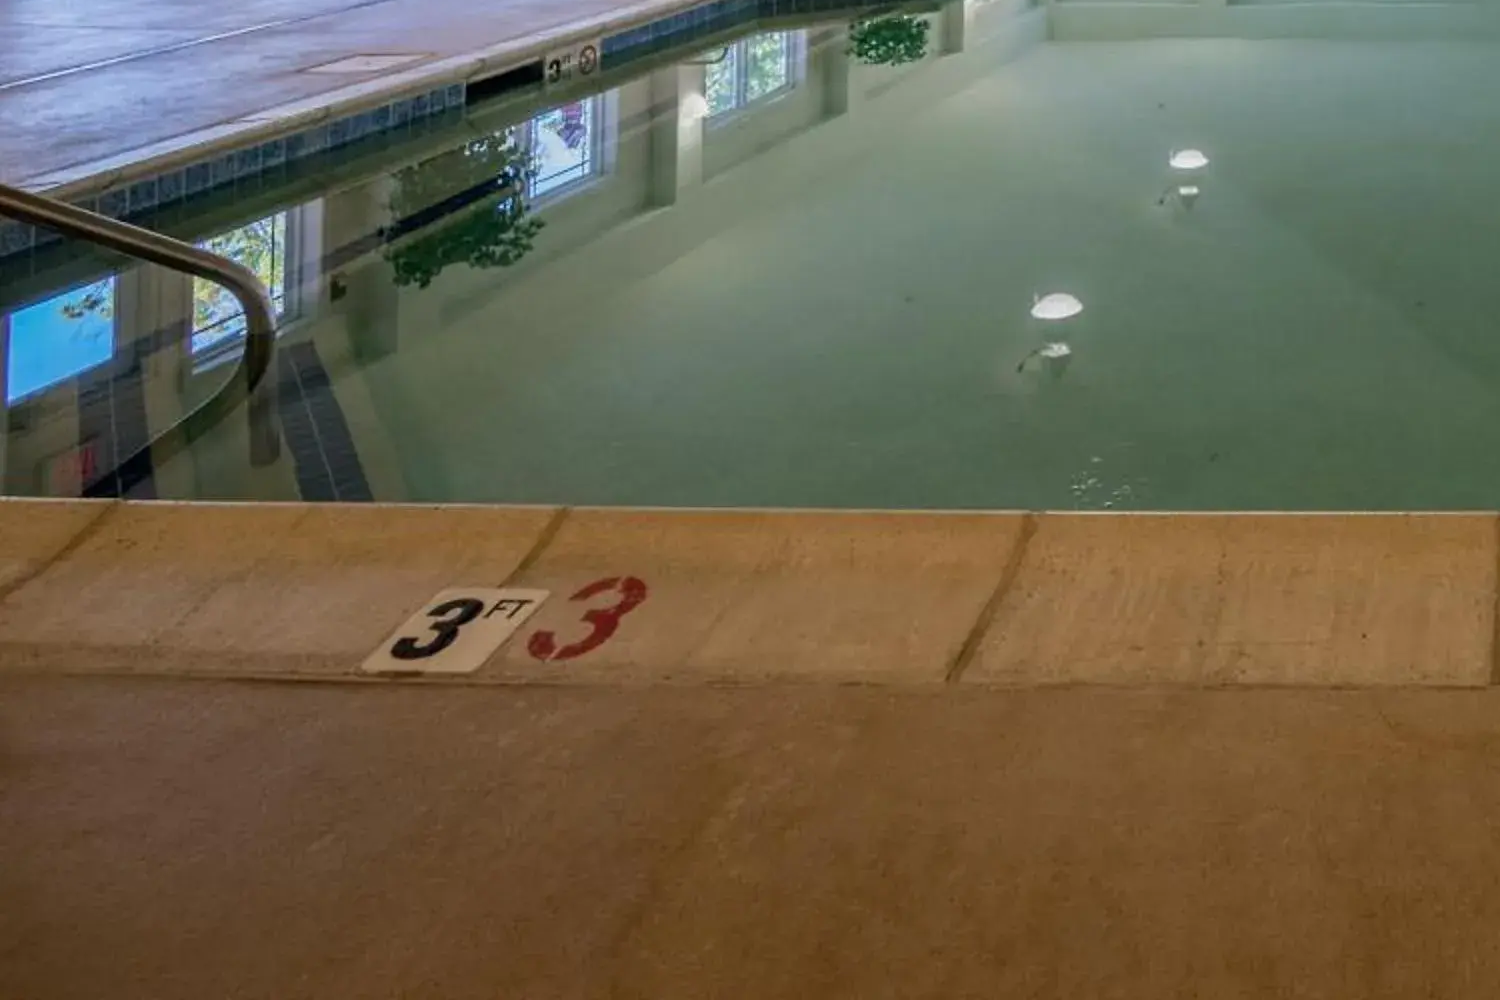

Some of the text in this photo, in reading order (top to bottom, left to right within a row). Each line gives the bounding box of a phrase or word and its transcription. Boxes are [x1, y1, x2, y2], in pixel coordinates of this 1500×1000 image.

[391, 598, 534, 660] 3 FT
[527, 576, 647, 660] 3
